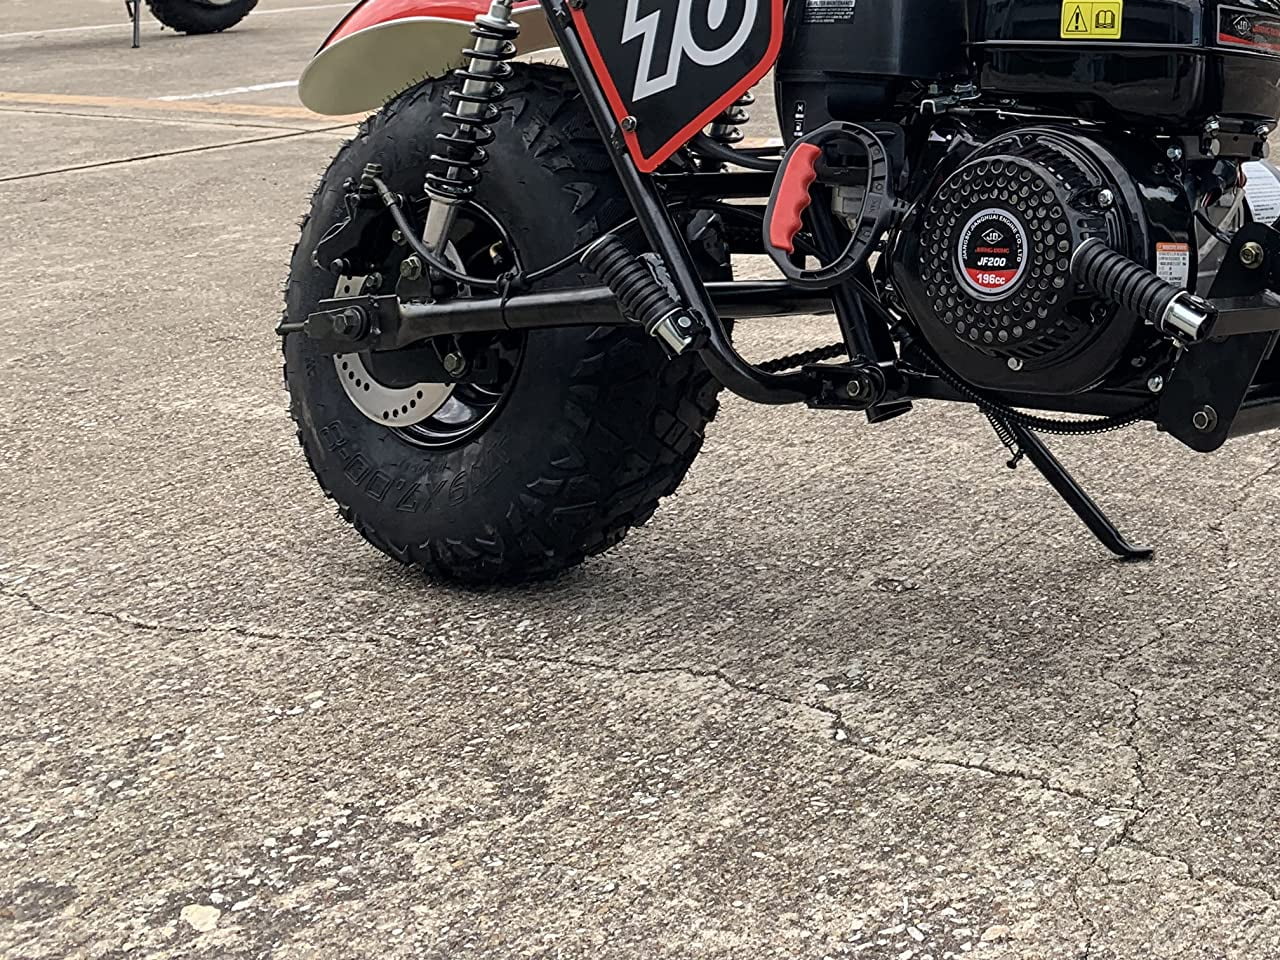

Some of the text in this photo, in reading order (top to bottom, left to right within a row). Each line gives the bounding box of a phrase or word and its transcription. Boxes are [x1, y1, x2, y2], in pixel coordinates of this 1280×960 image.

[962, 231, 971, 260] JIANGSU
[999, 215, 1018, 234] ENGINE
[986, 232, 999, 241] JD
[977, 257, 1006, 267] JF200
[976, 273, 1006, 285] 196cc
